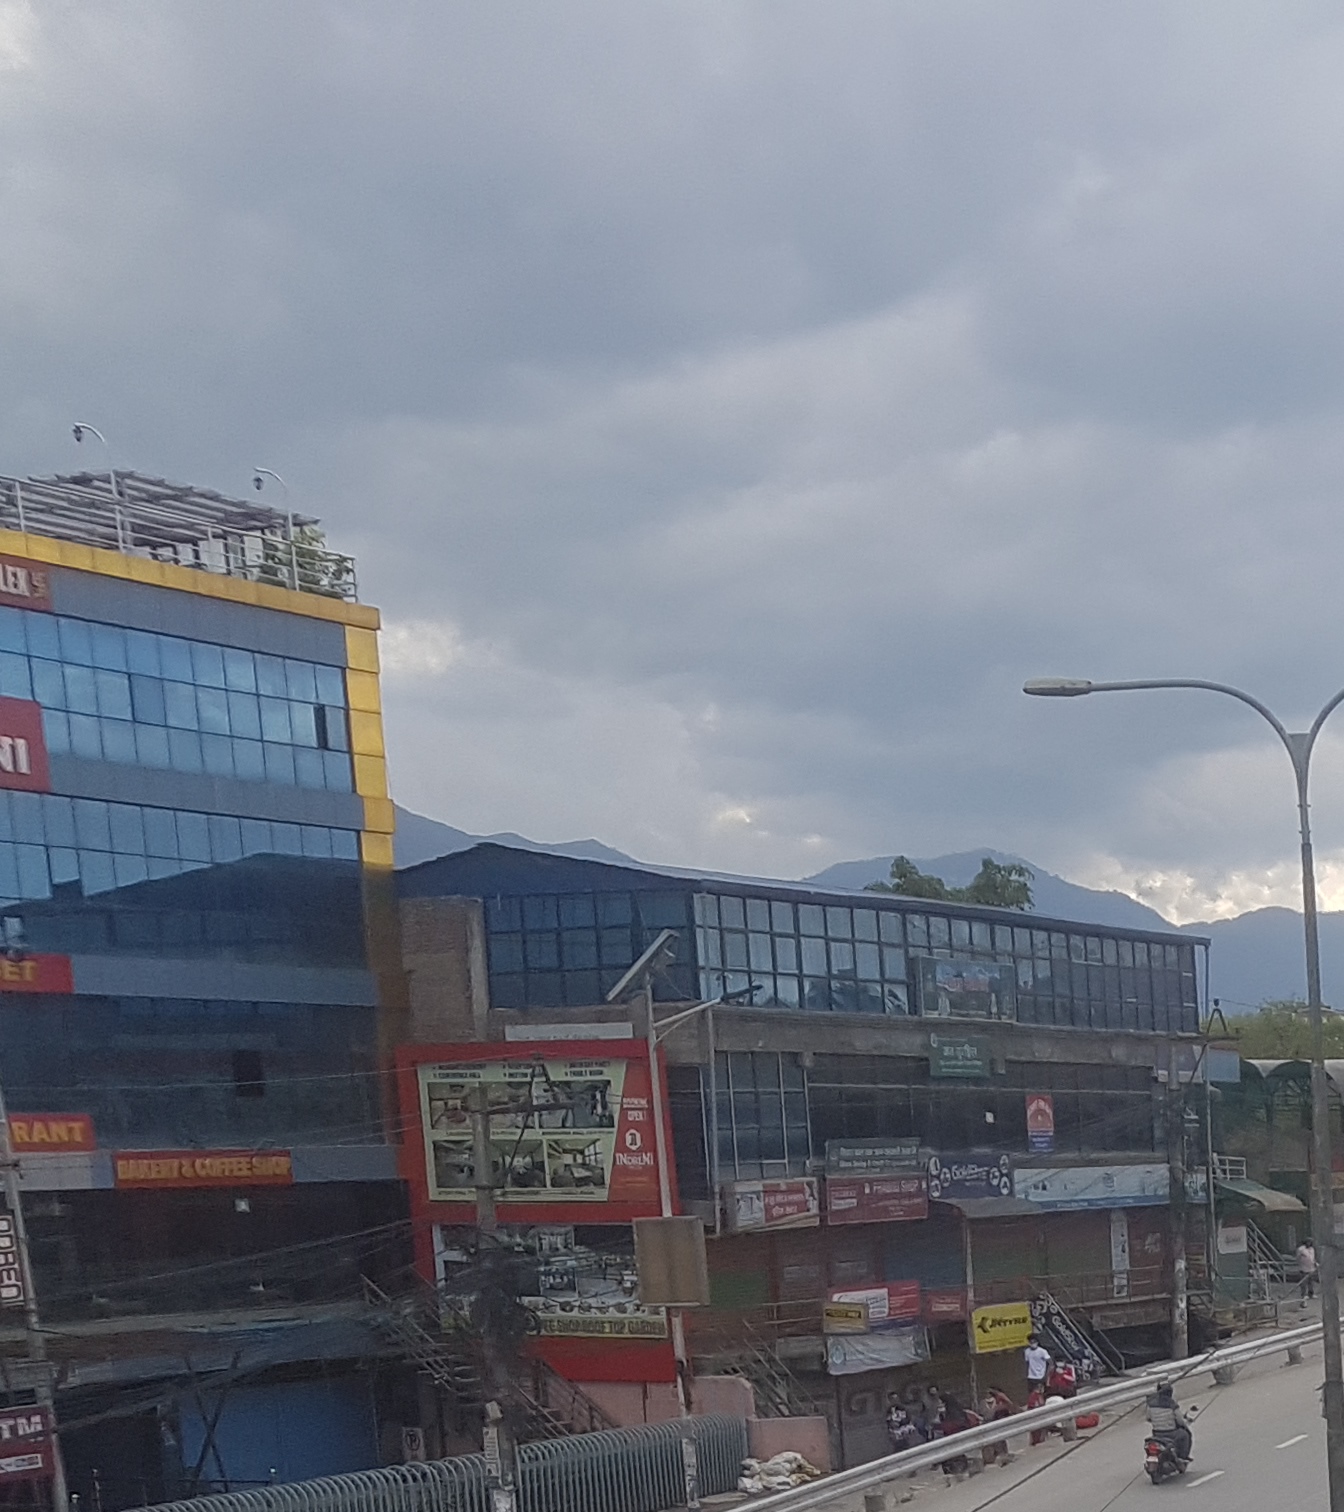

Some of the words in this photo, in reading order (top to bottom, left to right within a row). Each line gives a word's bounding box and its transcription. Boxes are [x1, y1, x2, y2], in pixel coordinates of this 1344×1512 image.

[11, 1121, 85, 1143] RANT
[117, 1159, 179, 1179] BAKERY
[194, 1157, 252, 1178] COFFEE
